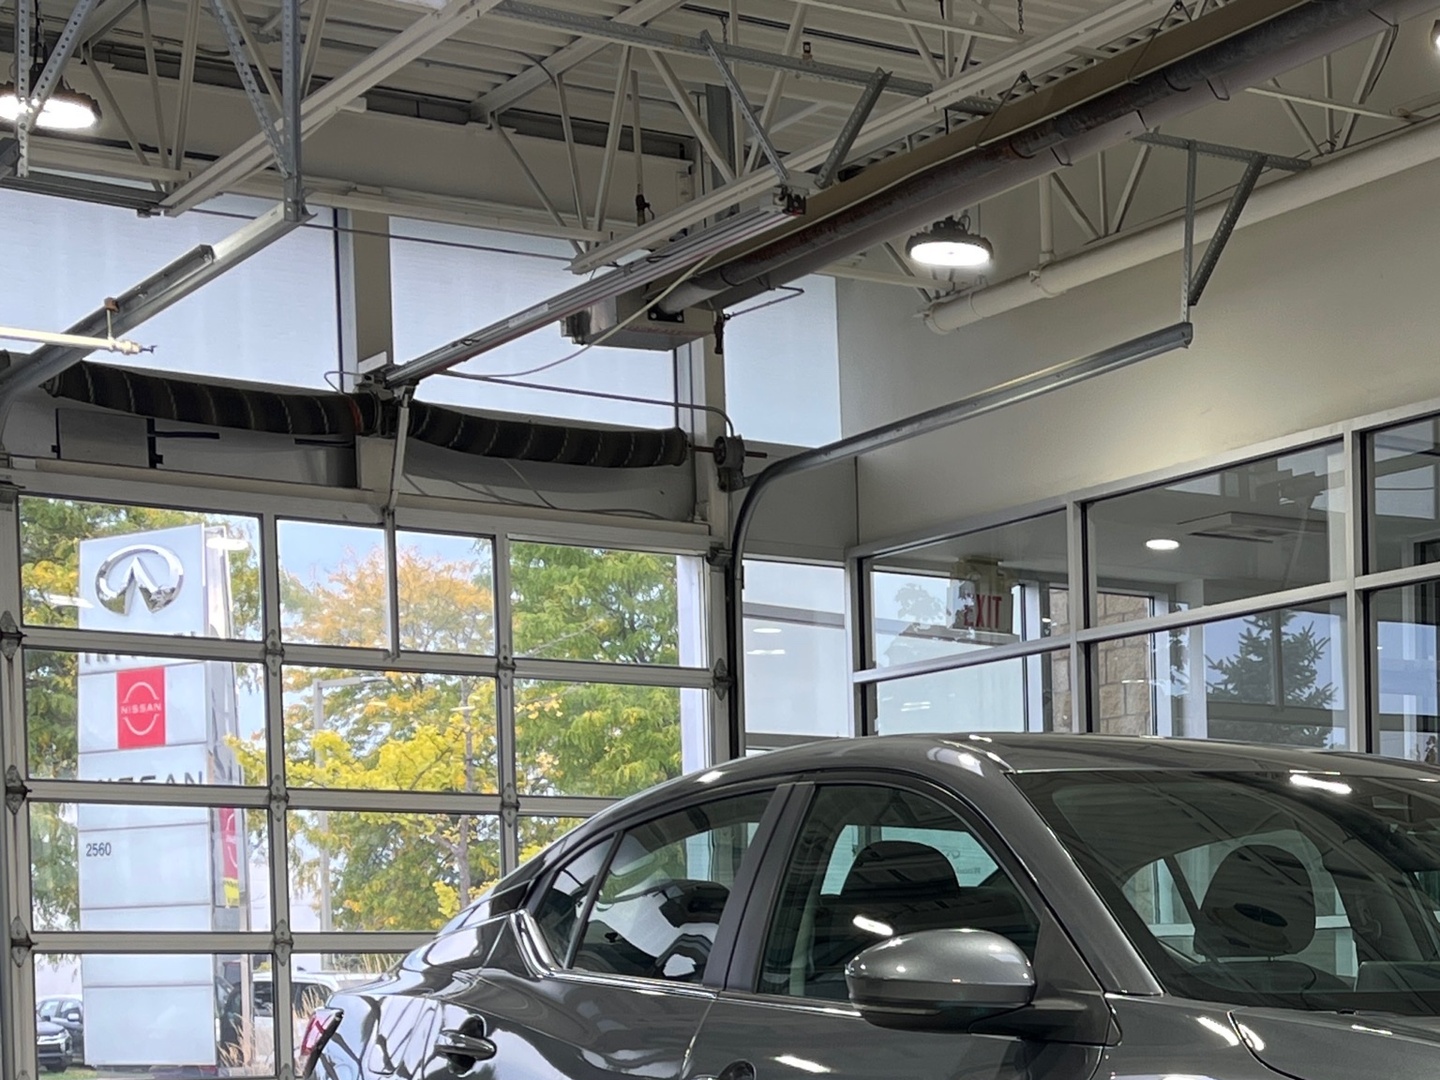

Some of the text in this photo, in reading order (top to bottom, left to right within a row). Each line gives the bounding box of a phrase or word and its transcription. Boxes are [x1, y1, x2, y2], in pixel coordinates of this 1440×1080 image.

[963, 593, 1002, 629] EXIT
[120, 703, 162, 714] NISSAN
[86, 842, 112, 857] 2560
